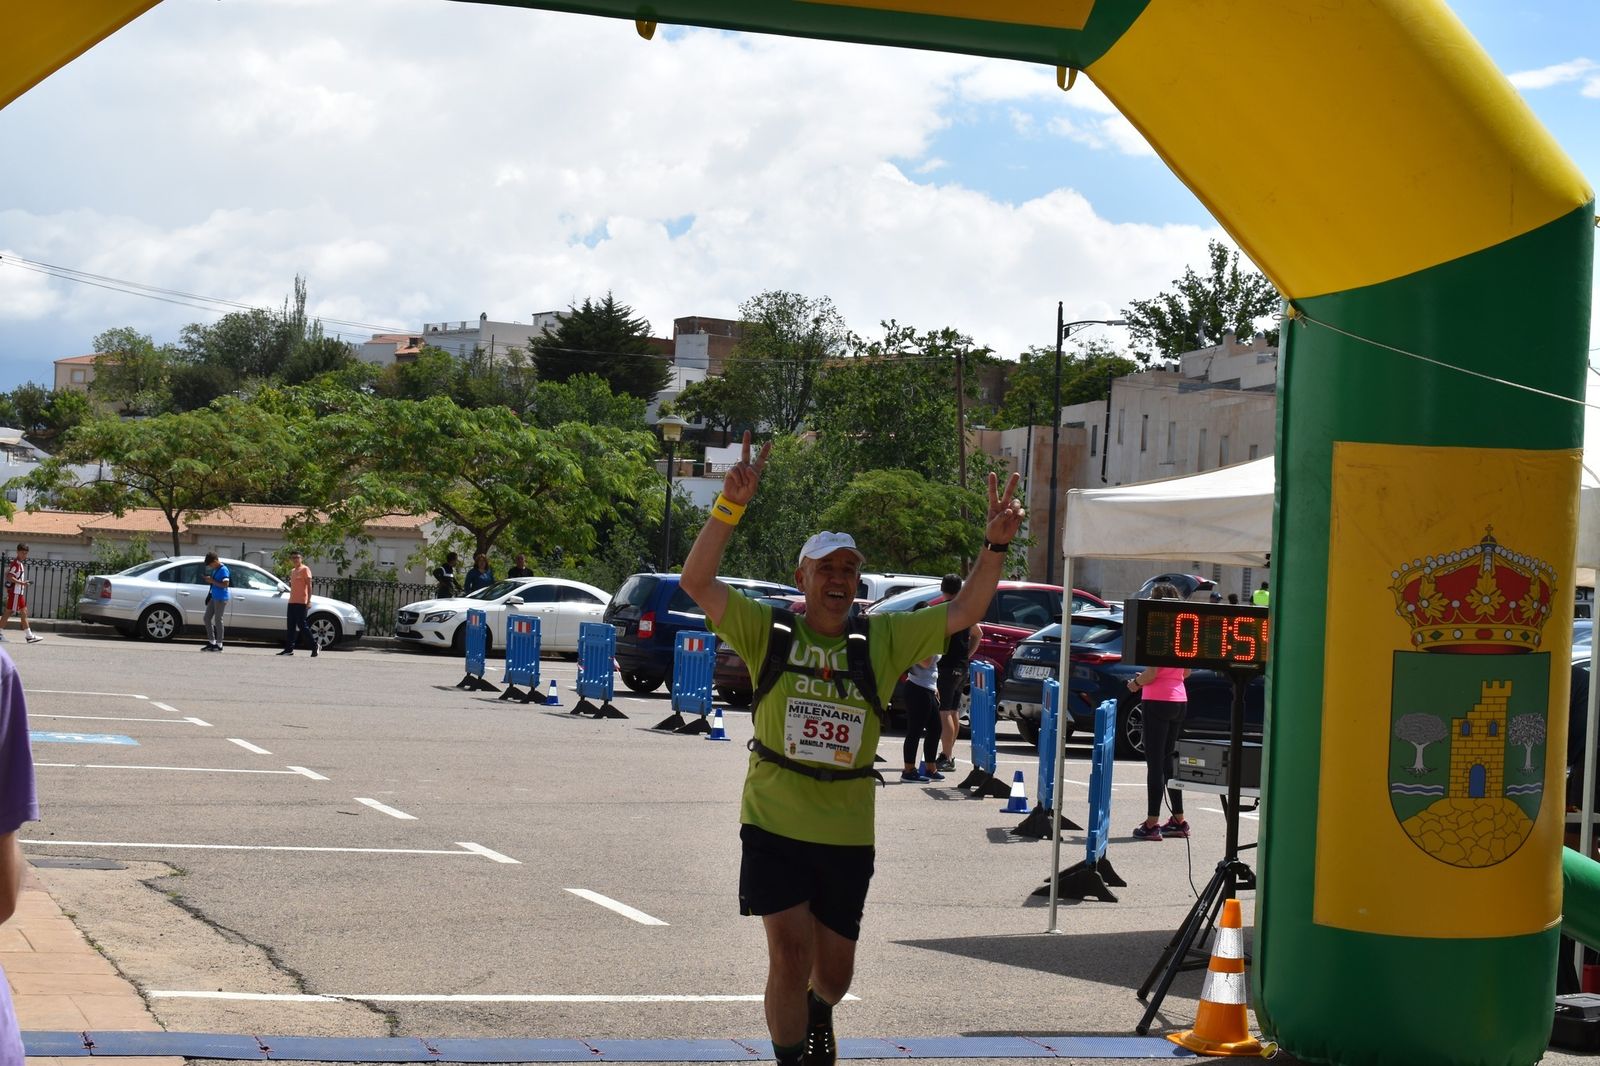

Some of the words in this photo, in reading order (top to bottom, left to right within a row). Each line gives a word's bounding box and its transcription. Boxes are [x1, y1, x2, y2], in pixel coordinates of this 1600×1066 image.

[1174, 612, 1268, 661] 01:5
[788, 704, 862, 724] MILENARIA
[794, 700, 822, 708] CARRERA
[802, 719, 850, 744] 538
[799, 739, 823, 748] MANOLO
